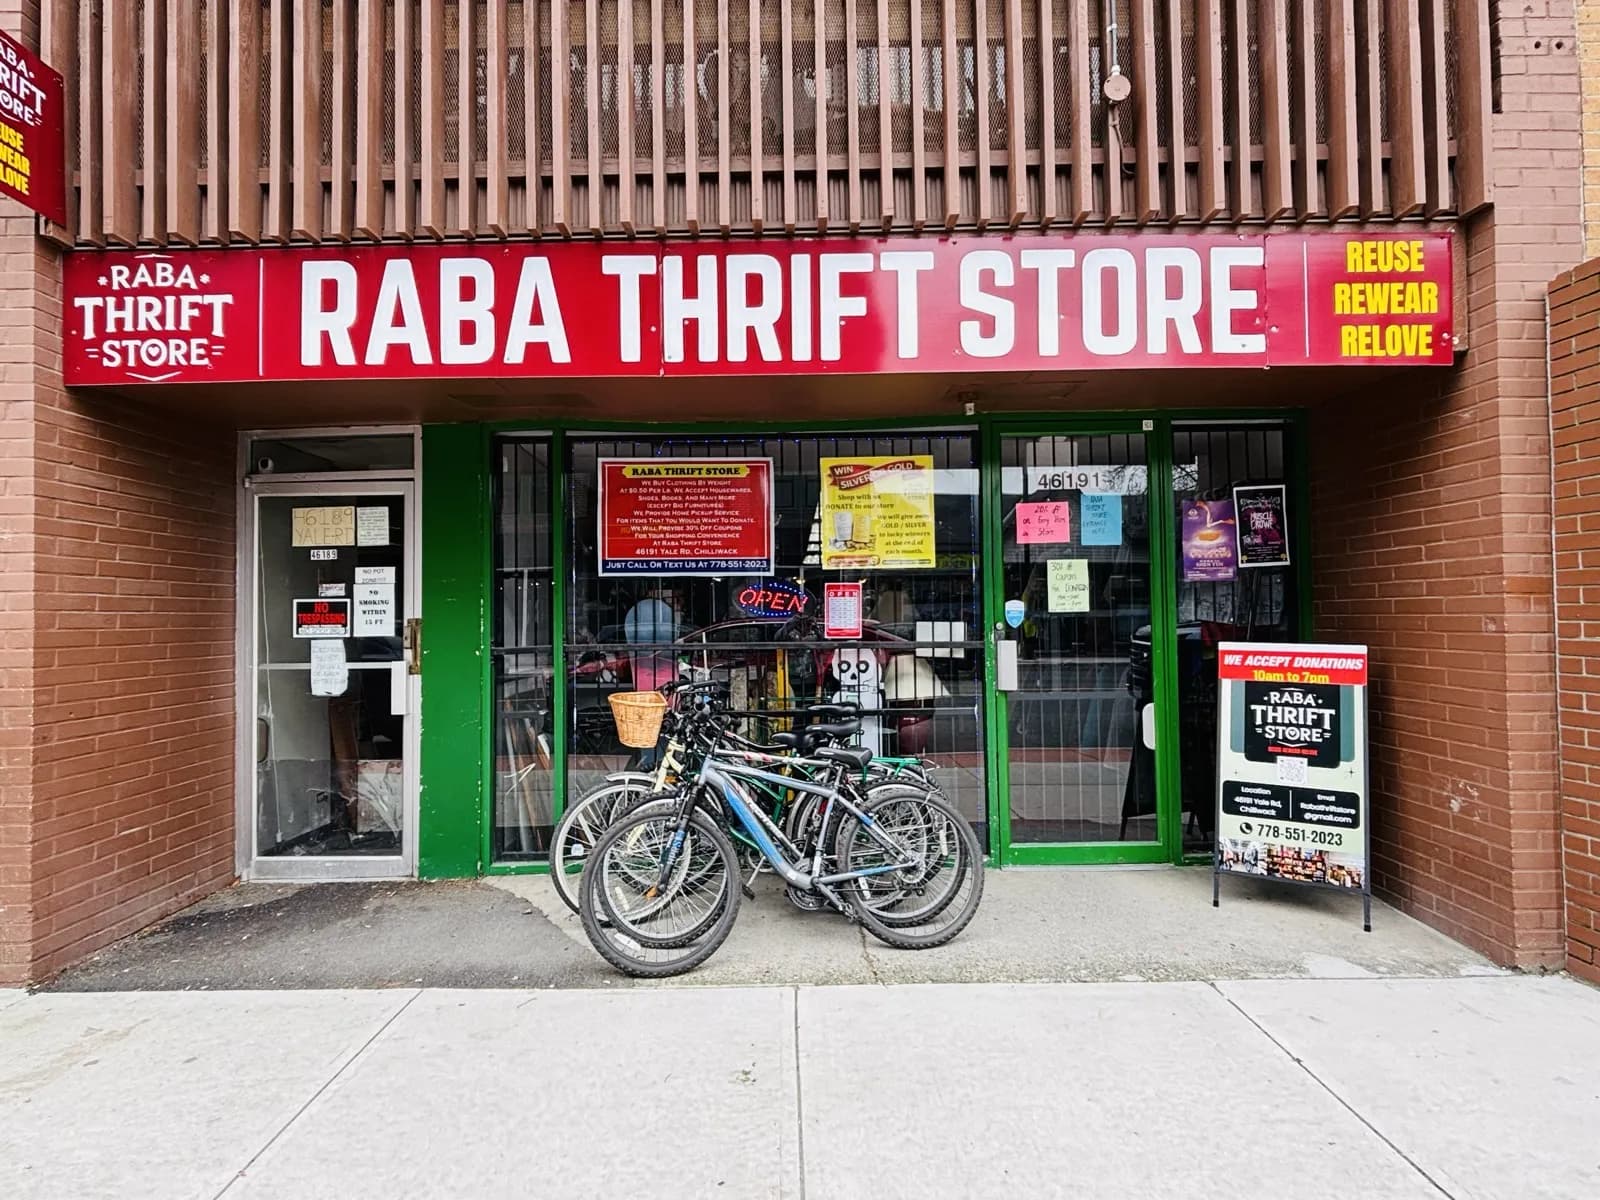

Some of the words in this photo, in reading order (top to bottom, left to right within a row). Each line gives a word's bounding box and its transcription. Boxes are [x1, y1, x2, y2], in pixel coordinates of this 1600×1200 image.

[1346, 240, 1425, 273] REUSE
[110, 263, 198, 290] RABA
[300, 256, 572, 366] RABA
[601, 250, 934, 363] THRIFT
[958, 246, 1266, 358] STORE
[1334, 282, 1439, 315] REWEAR
[74, 293, 234, 340] THRIFT
[1341, 324, 1434, 357] RELOVE
[102, 338, 209, 367] STORE
[632, 468, 662, 476] RABA
[664, 467, 703, 476] THRIFT
[706, 467, 741, 475] STORE
[833, 466, 854, 475] WIN
[840, 474, 870, 489] SILVER
[886, 463, 913, 473] GOLD
[1038, 472, 1100, 489] 46191
[312, 550, 337, 559] 46189
[606, 561, 626, 569] JUST
[626, 561, 648, 569] CALL
[650, 561, 662, 569] OR
[710, 560, 767, 568] 778-551-2023
[314, 603, 329, 612] NO
[739, 588, 808, 613] OPEN
[298, 613, 346, 625] TRESPASSING
[1223, 654, 1243, 665] WE
[1245, 656, 1291, 667] ACCEPT
[1293, 657, 1364, 670] DONATIONS
[1253, 670, 1284, 682] 10am
[1286, 671, 1300, 682] to
[1270, 692, 1316, 706] RABA
[1250, 704, 1336, 730] THRIFT
[1264, 725, 1323, 742] STORE
[1240, 786, 1271, 796] Location
[1304, 812, 1352, 824] @gmail.com
[1257, 824, 1343, 846] 778-551-2023
